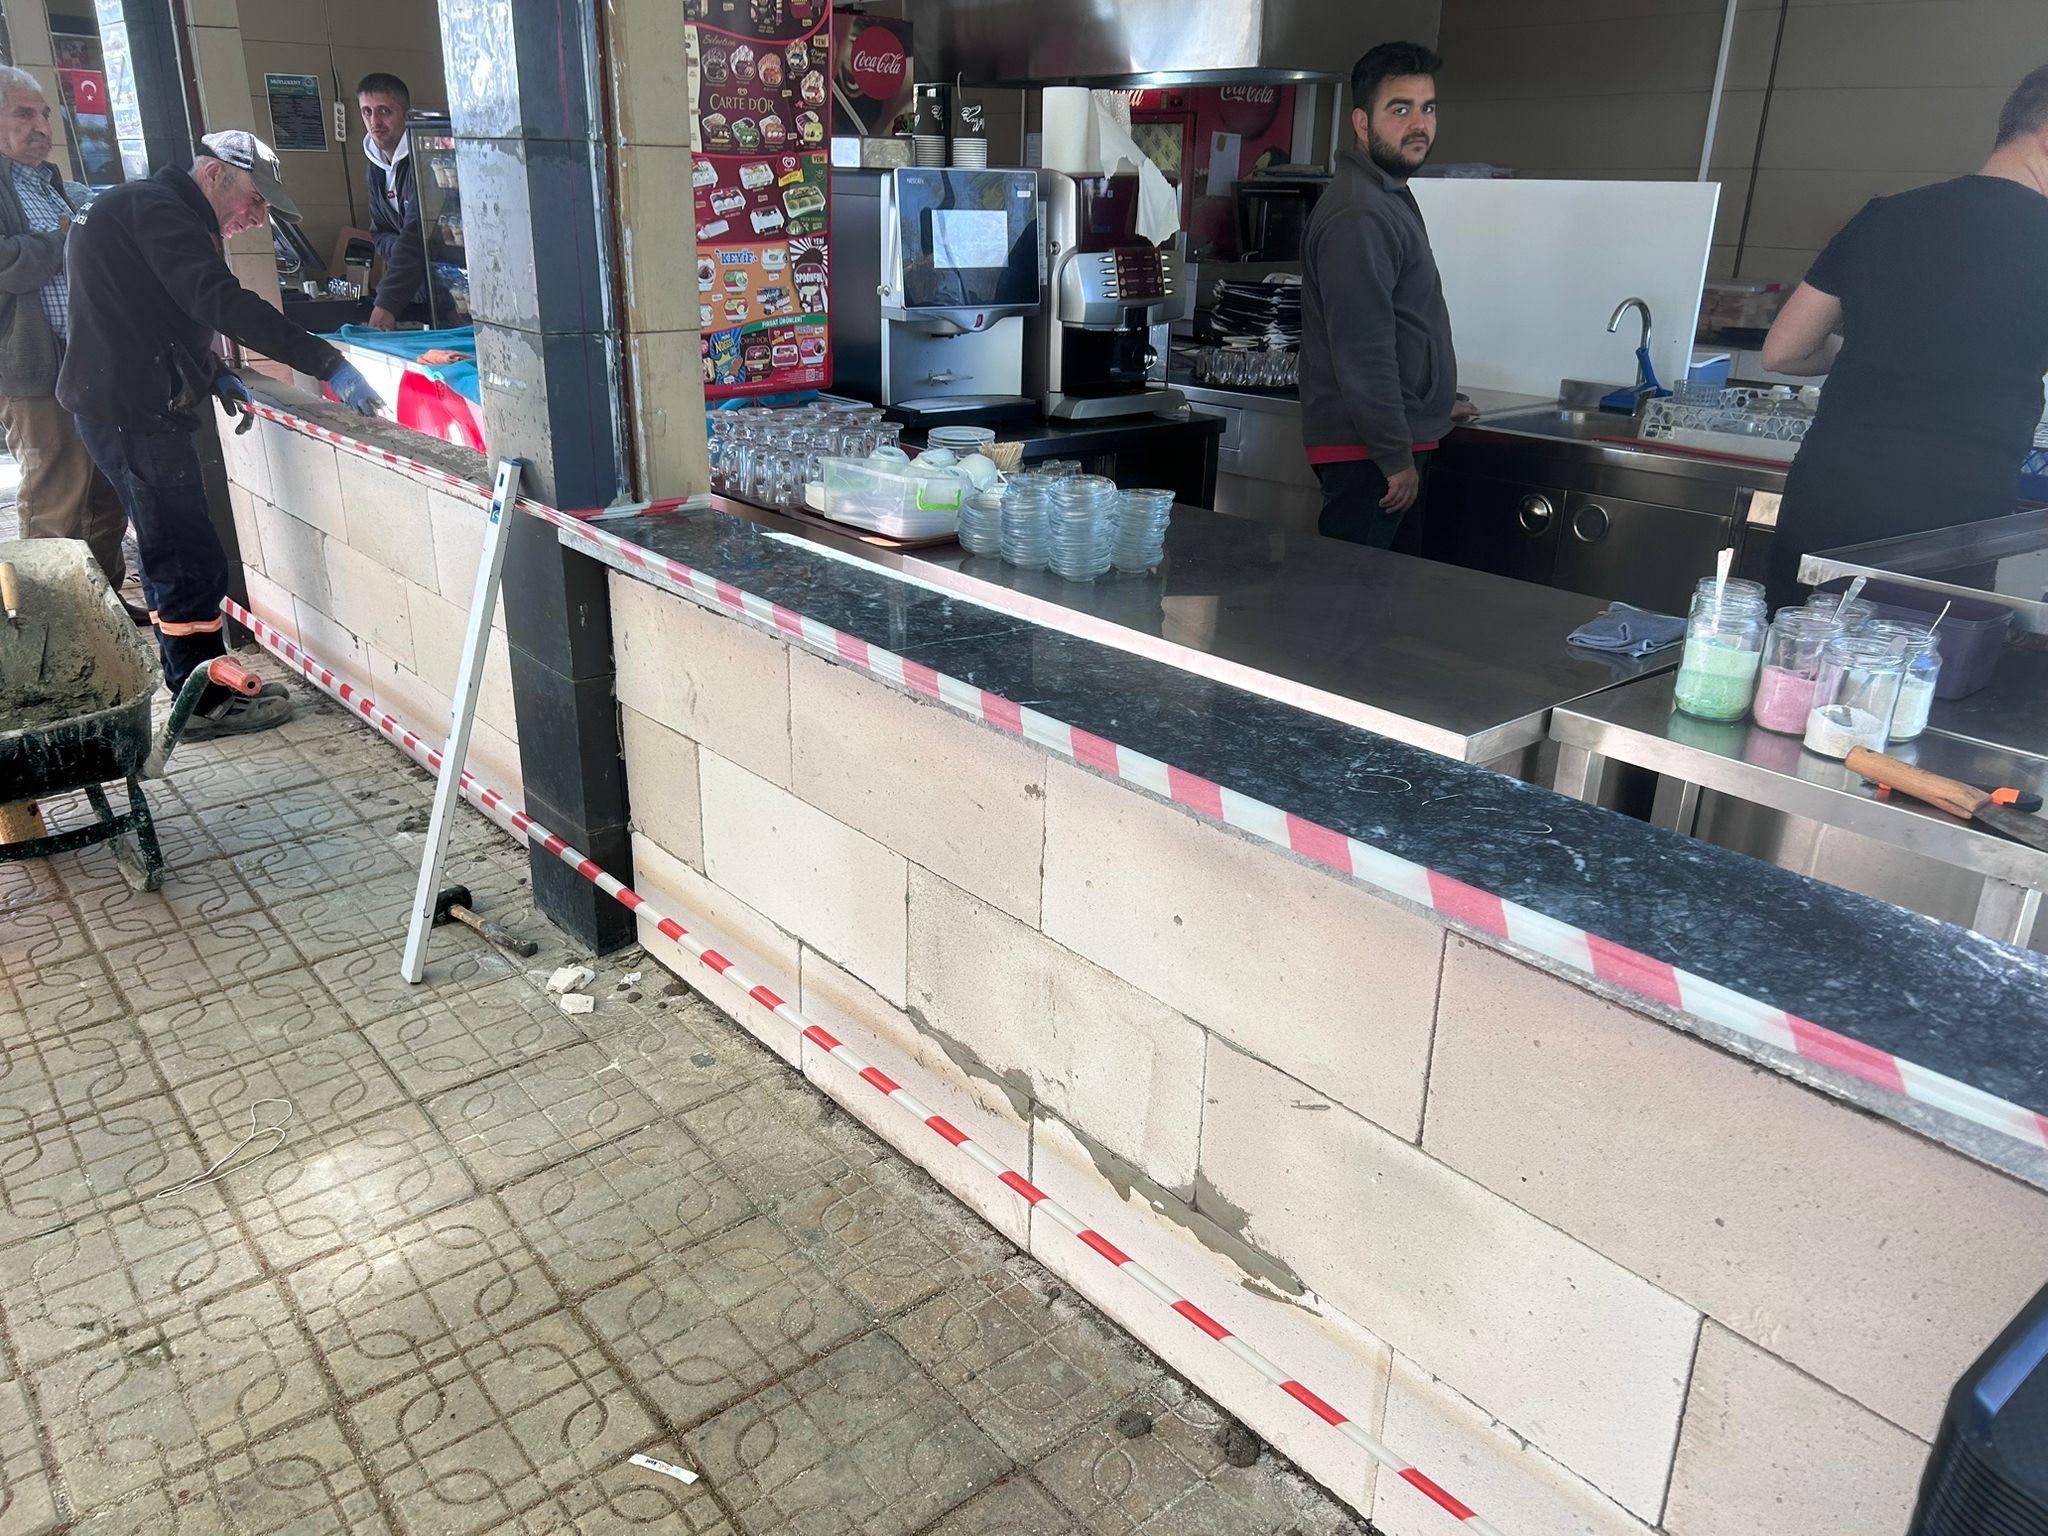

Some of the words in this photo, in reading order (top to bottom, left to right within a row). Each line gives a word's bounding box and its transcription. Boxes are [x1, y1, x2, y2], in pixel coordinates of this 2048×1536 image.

[853, 50, 903, 75] Coca-Cola
[709, 93, 746, 111] CARTE
[748, 96, 779, 115] D'OR
[721, 248, 754, 264] KEYİF
